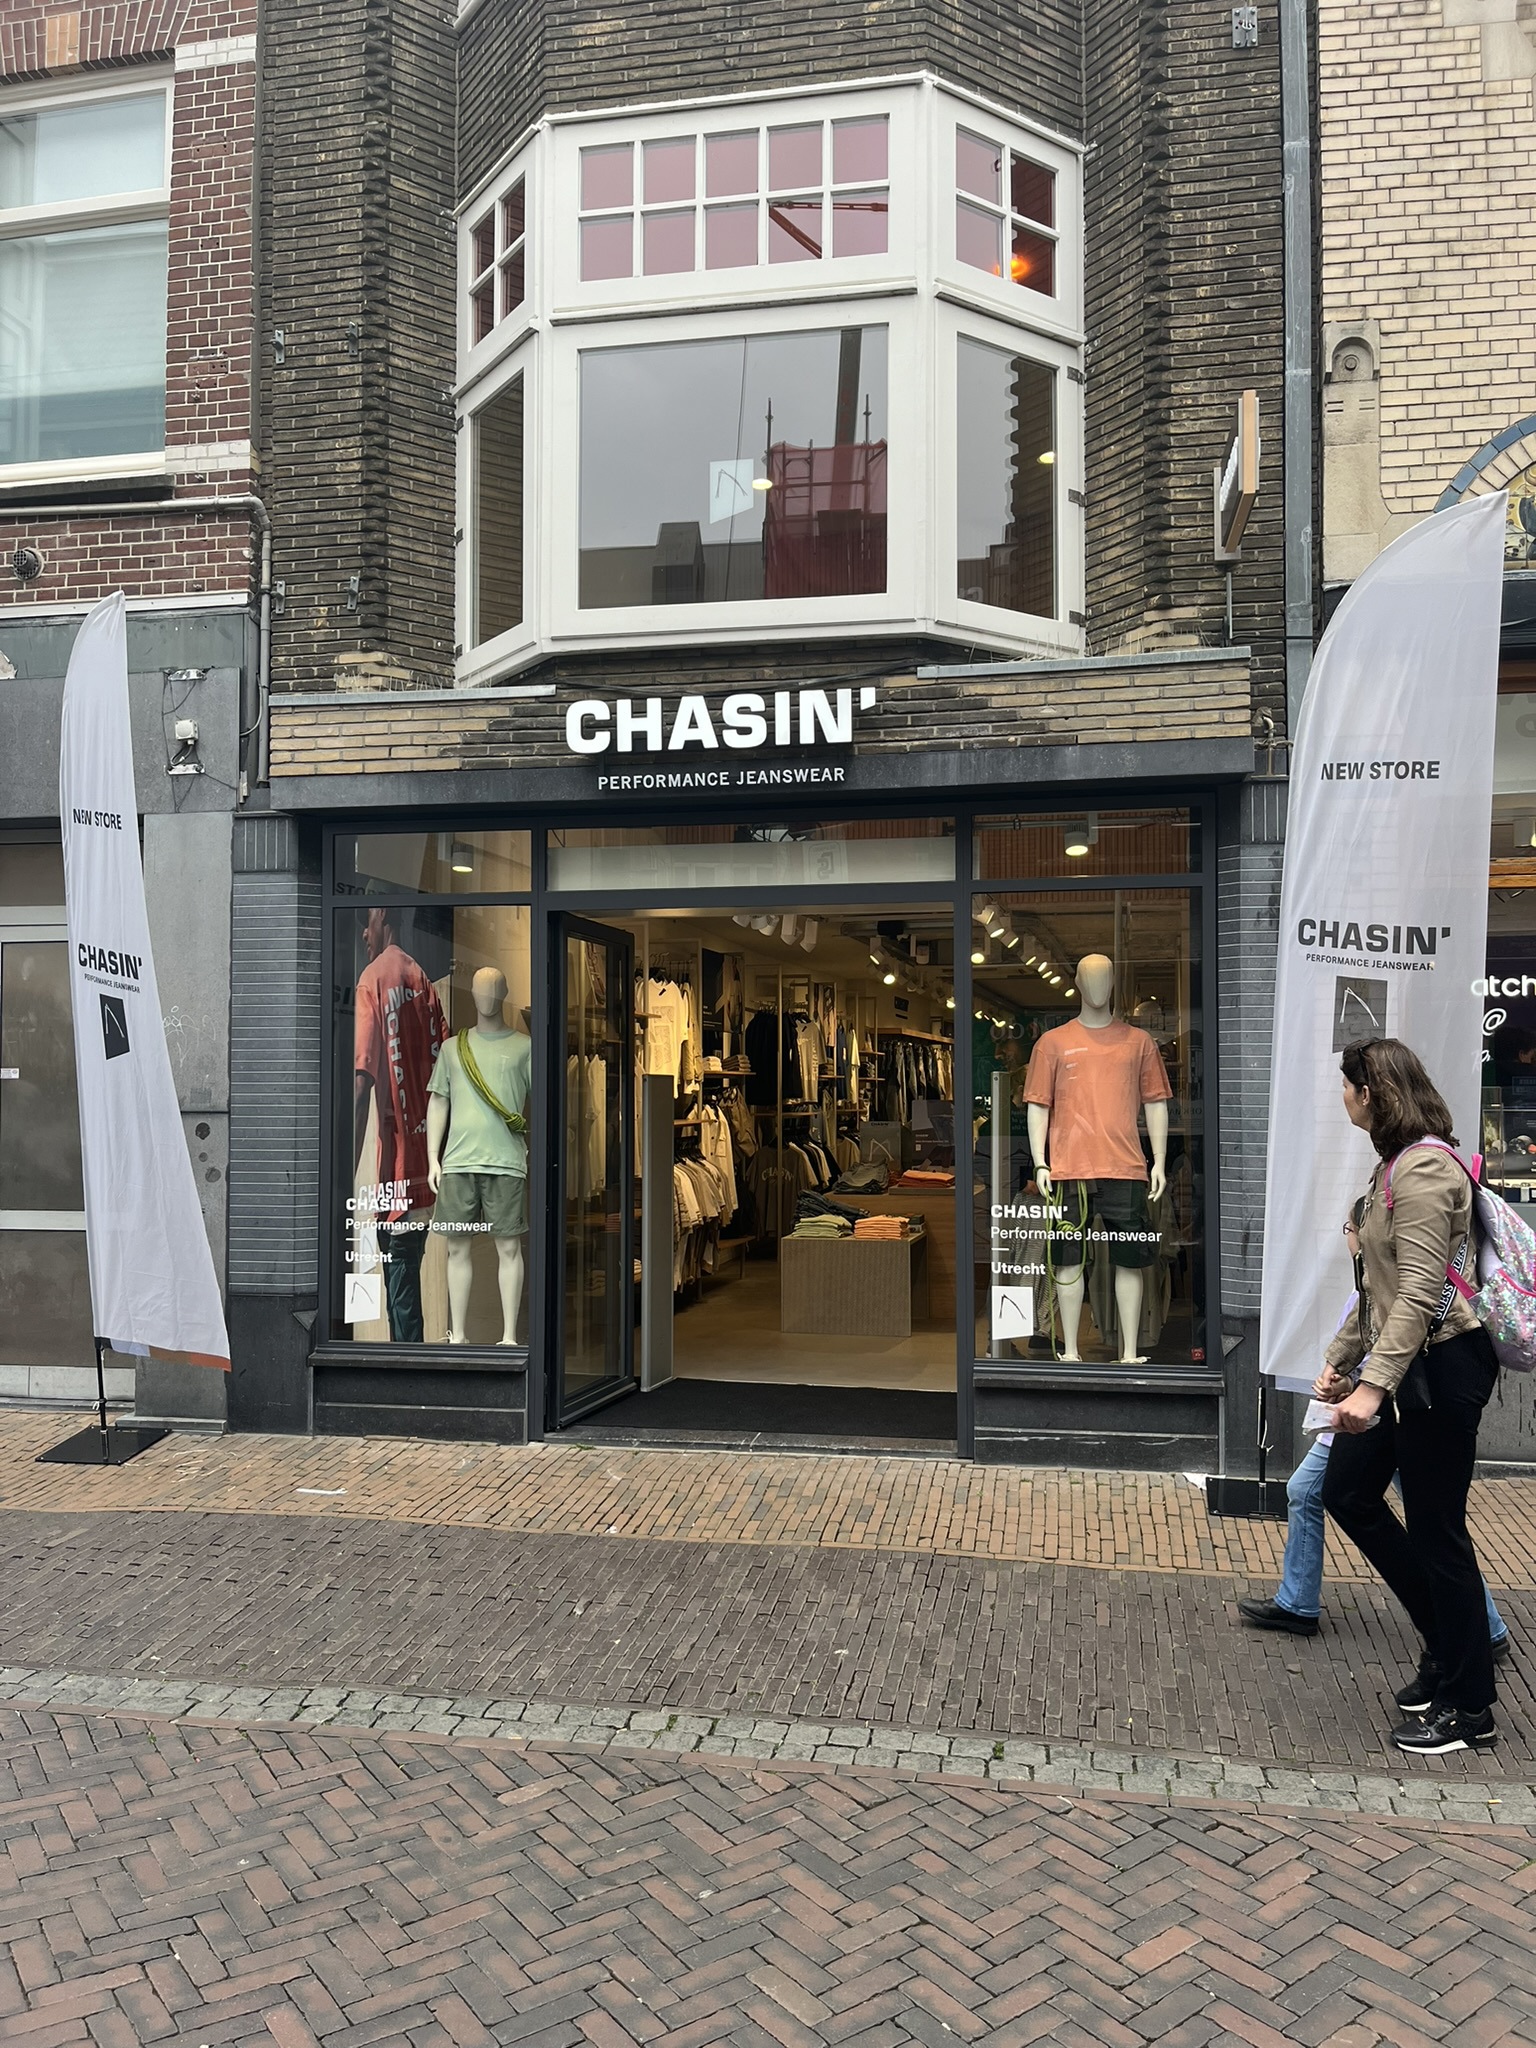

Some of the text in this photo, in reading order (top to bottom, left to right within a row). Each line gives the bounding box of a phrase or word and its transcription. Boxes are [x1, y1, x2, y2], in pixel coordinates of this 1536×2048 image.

[566, 687, 876, 753] CHASIN'
[598, 767, 845, 790] PERFORMANCE JEANSWEAR
[1321, 761, 1441, 780] NEW STORE
[94, 811, 122, 830] STORE
[1298, 918, 1451, 955] CHASIN'
[78, 943, 143, 980] CHASIN'
[1306, 953, 1434, 971] PERFORMANCE JEANSWEAR
[346, 1197, 413, 1211] CHASIN'
[990, 1204, 1068, 1219] CHASIN'
[345, 1218, 493, 1232] Performance Jeanswear
[990, 1226, 1162, 1242] Performance Jeanswear
[345, 1251, 392, 1263] Utrecht
[990, 1261, 1046, 1275] Utrecht
